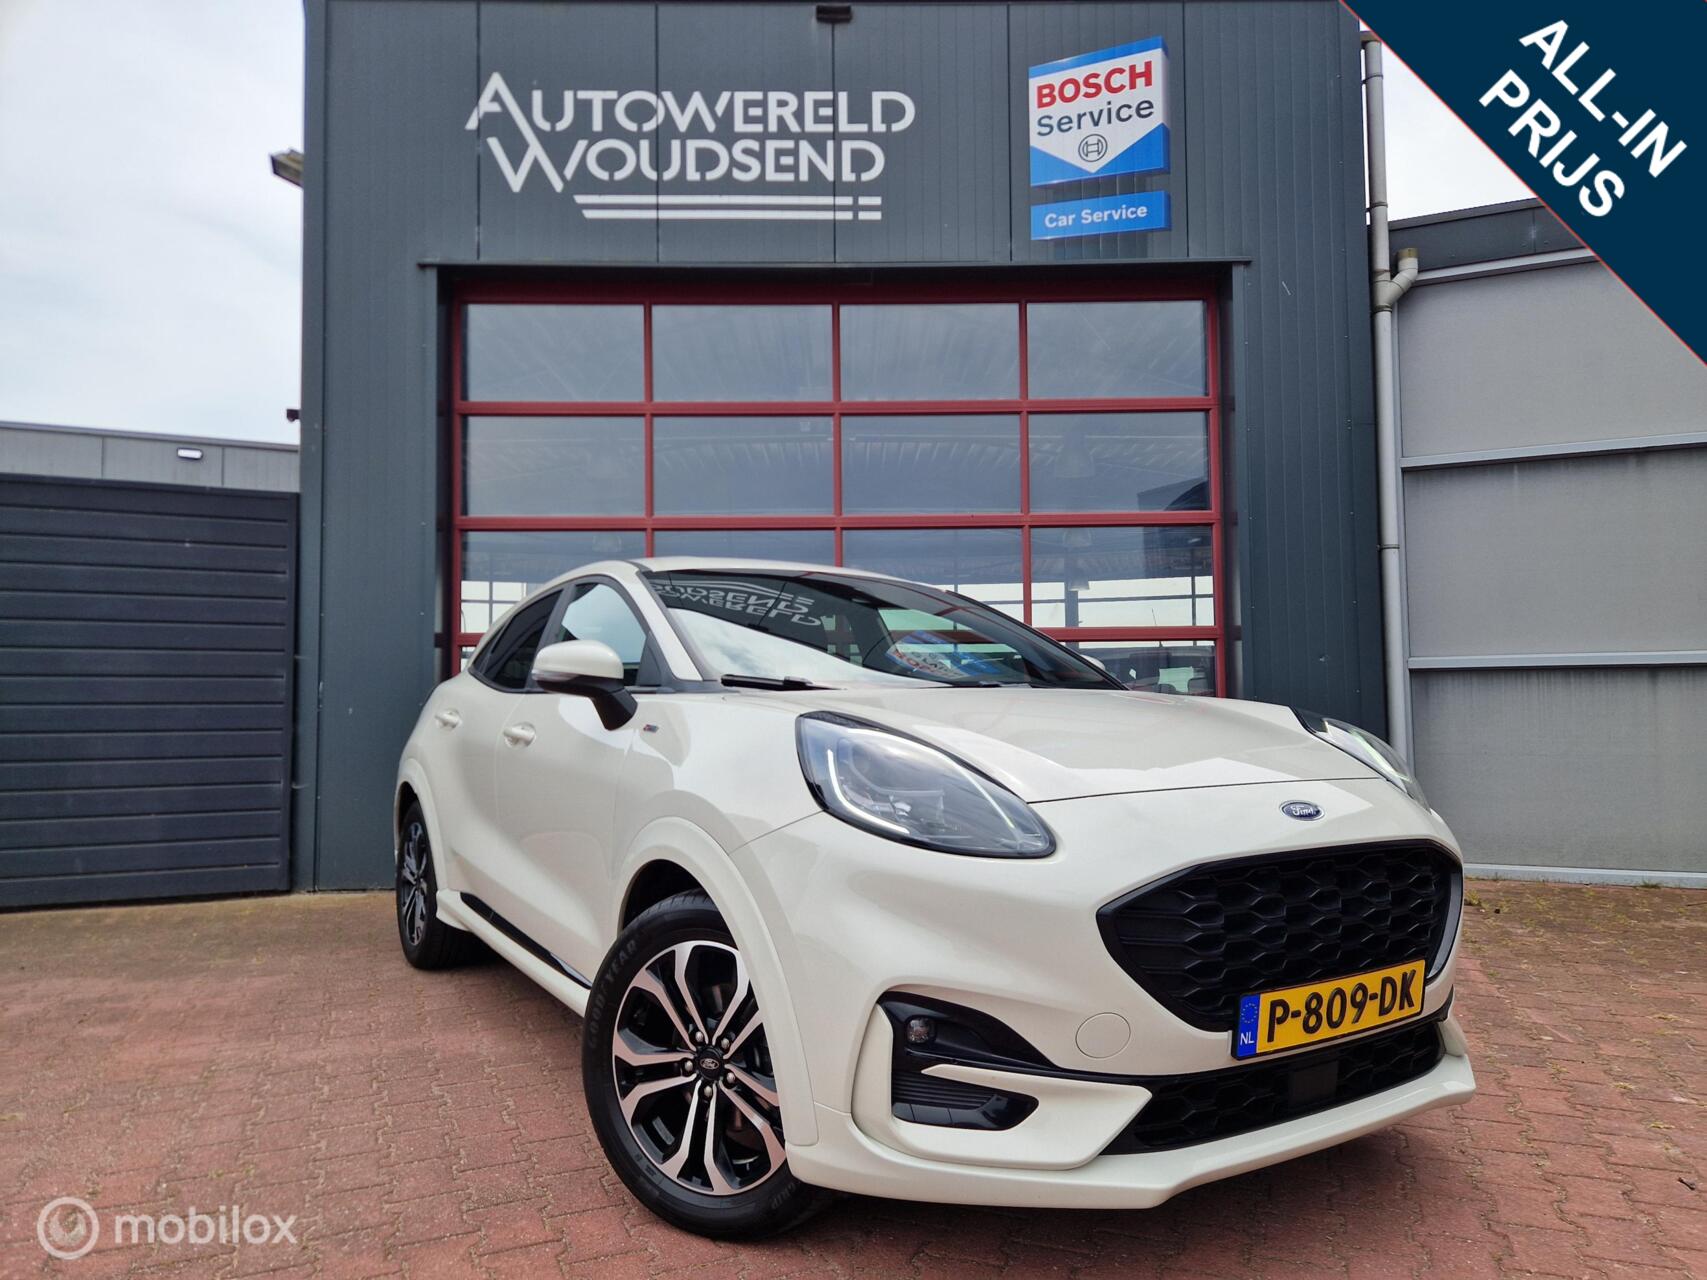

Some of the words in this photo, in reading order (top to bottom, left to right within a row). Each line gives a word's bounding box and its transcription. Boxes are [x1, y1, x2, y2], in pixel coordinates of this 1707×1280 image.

[465, 72, 916, 133] AUTOWERELD
[1036, 60, 1153, 109] BOSCH
[1036, 99, 1155, 137] Service
[486, 137, 886, 193] WOUDSEND
[1044, 212, 1075, 228] Car
[1081, 205, 1148, 224] Service
[1266, 969, 1417, 1043] P-809-DK
[1239, 1031, 1255, 1046] NL
